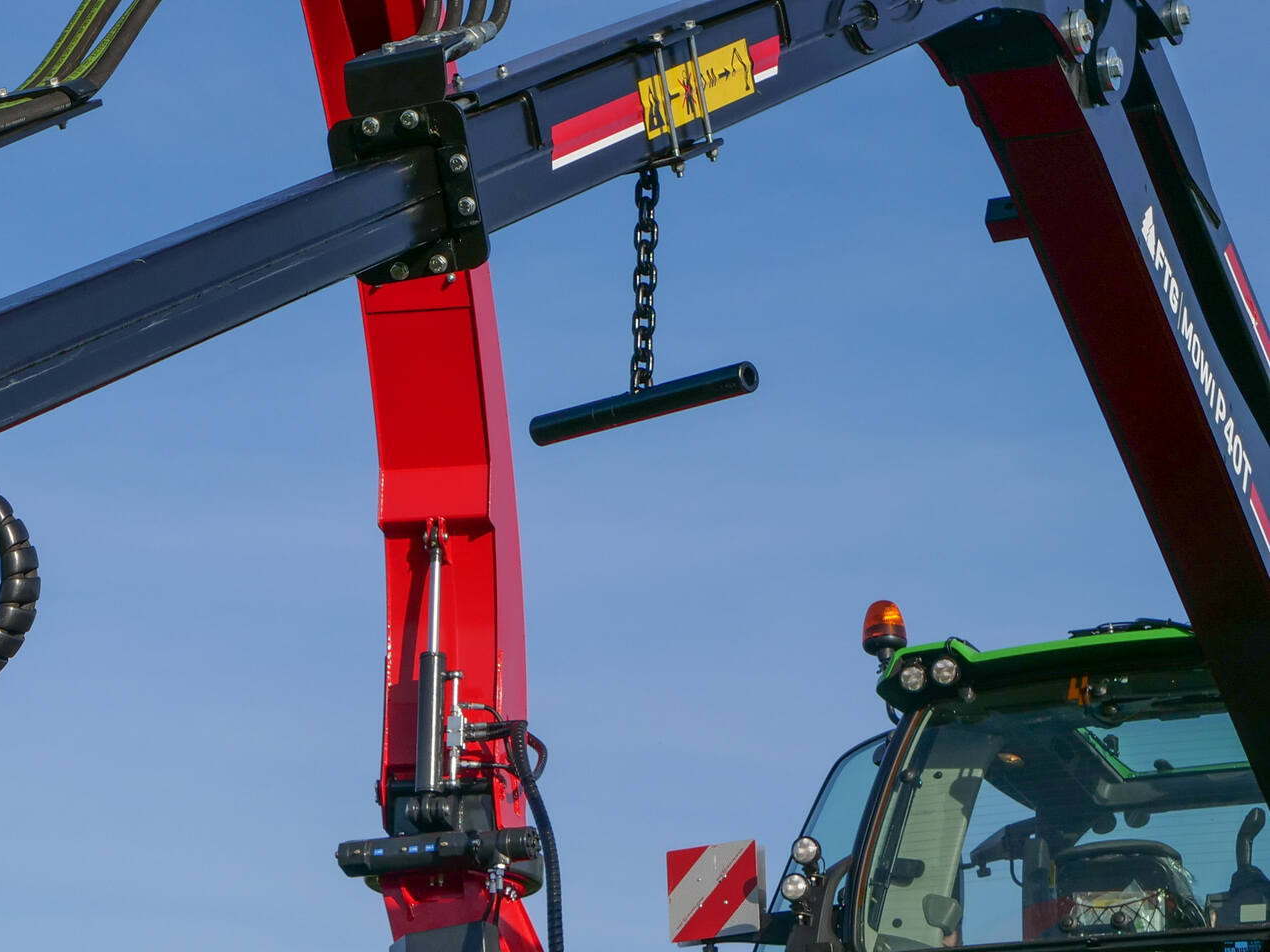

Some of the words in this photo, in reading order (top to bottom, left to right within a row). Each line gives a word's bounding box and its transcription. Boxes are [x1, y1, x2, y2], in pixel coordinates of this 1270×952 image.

[1154, 239, 1179, 314] FTG
[1181, 306, 1216, 409] MOWI
[1215, 387, 1252, 494] P40T
